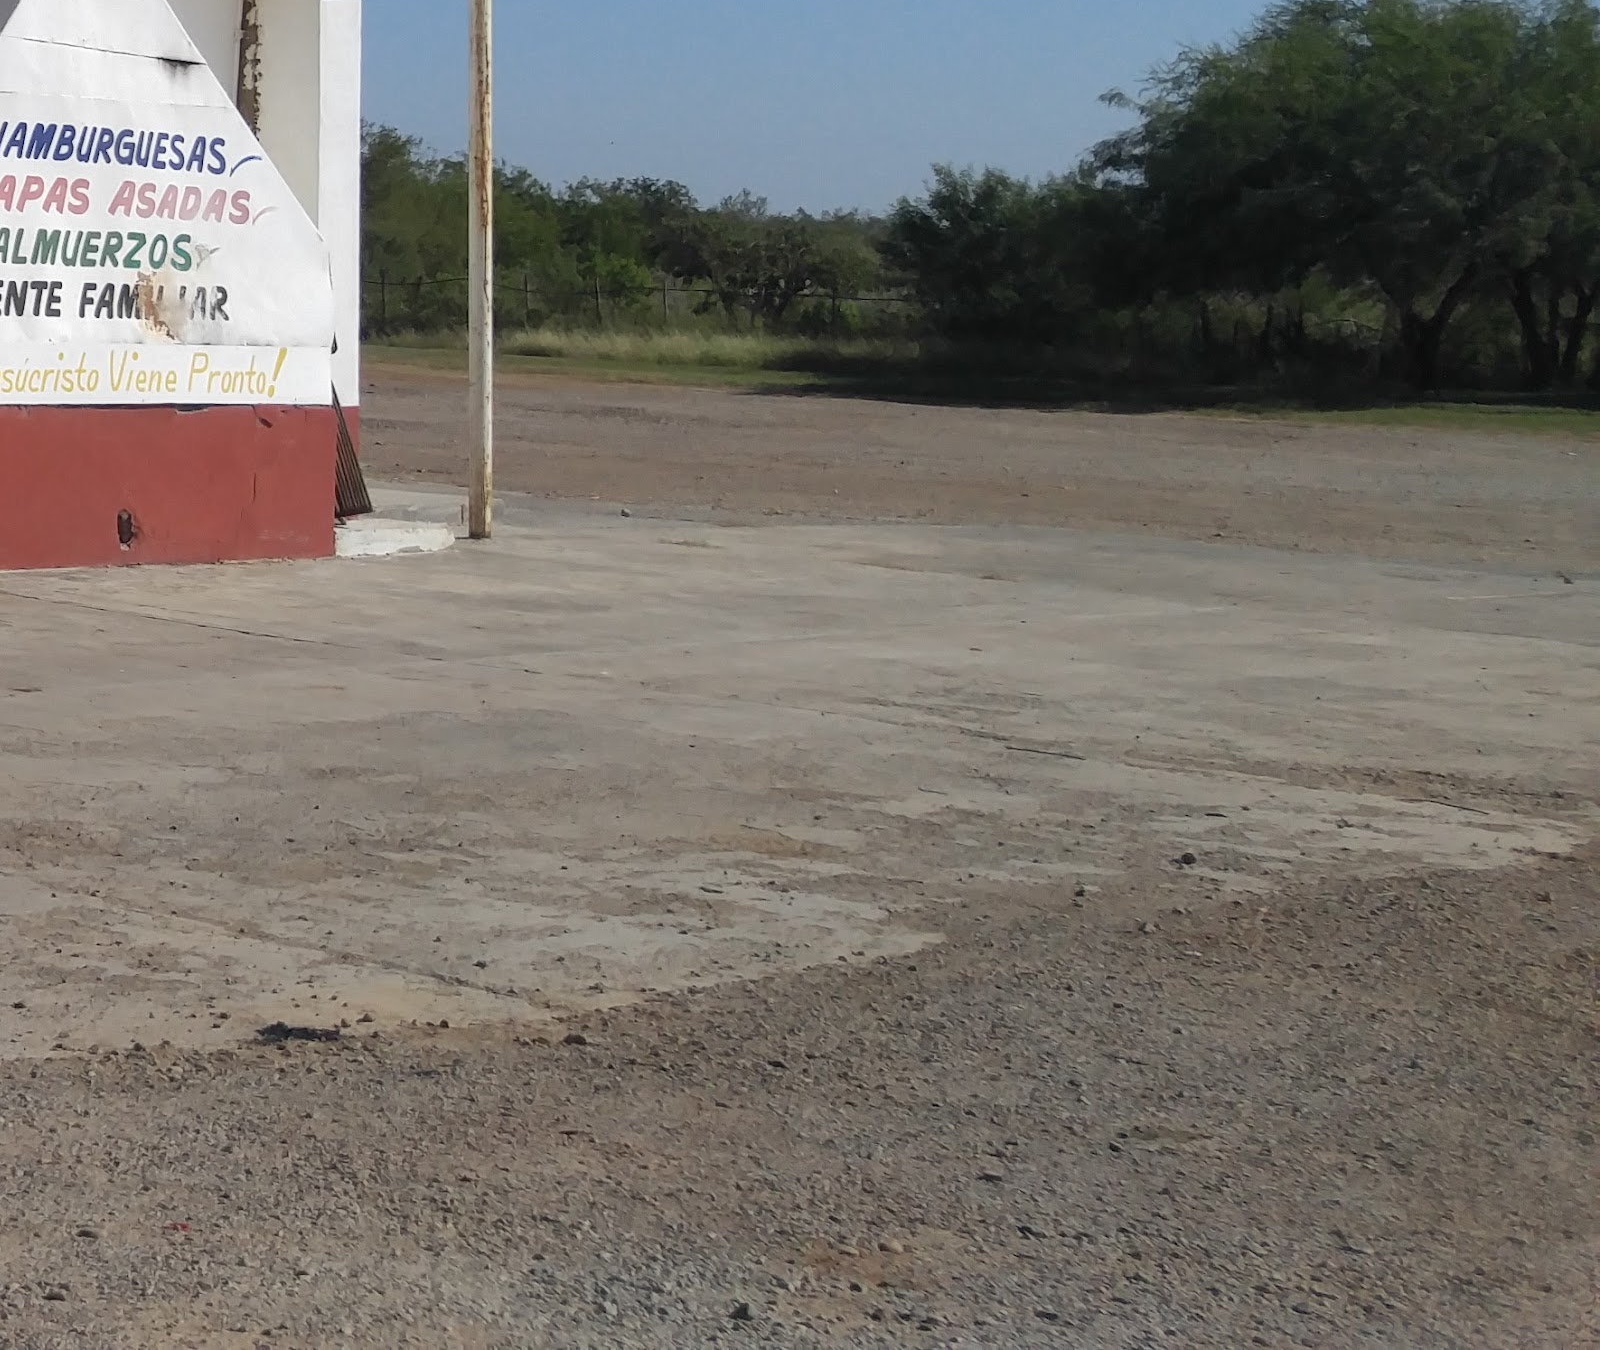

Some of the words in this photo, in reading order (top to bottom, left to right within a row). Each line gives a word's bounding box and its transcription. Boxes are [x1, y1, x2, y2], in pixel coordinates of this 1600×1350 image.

[107, 180, 252, 225] ASADAS
[109, 350, 177, 393] Viene
[187, 347, 288, 398] Pronto!
